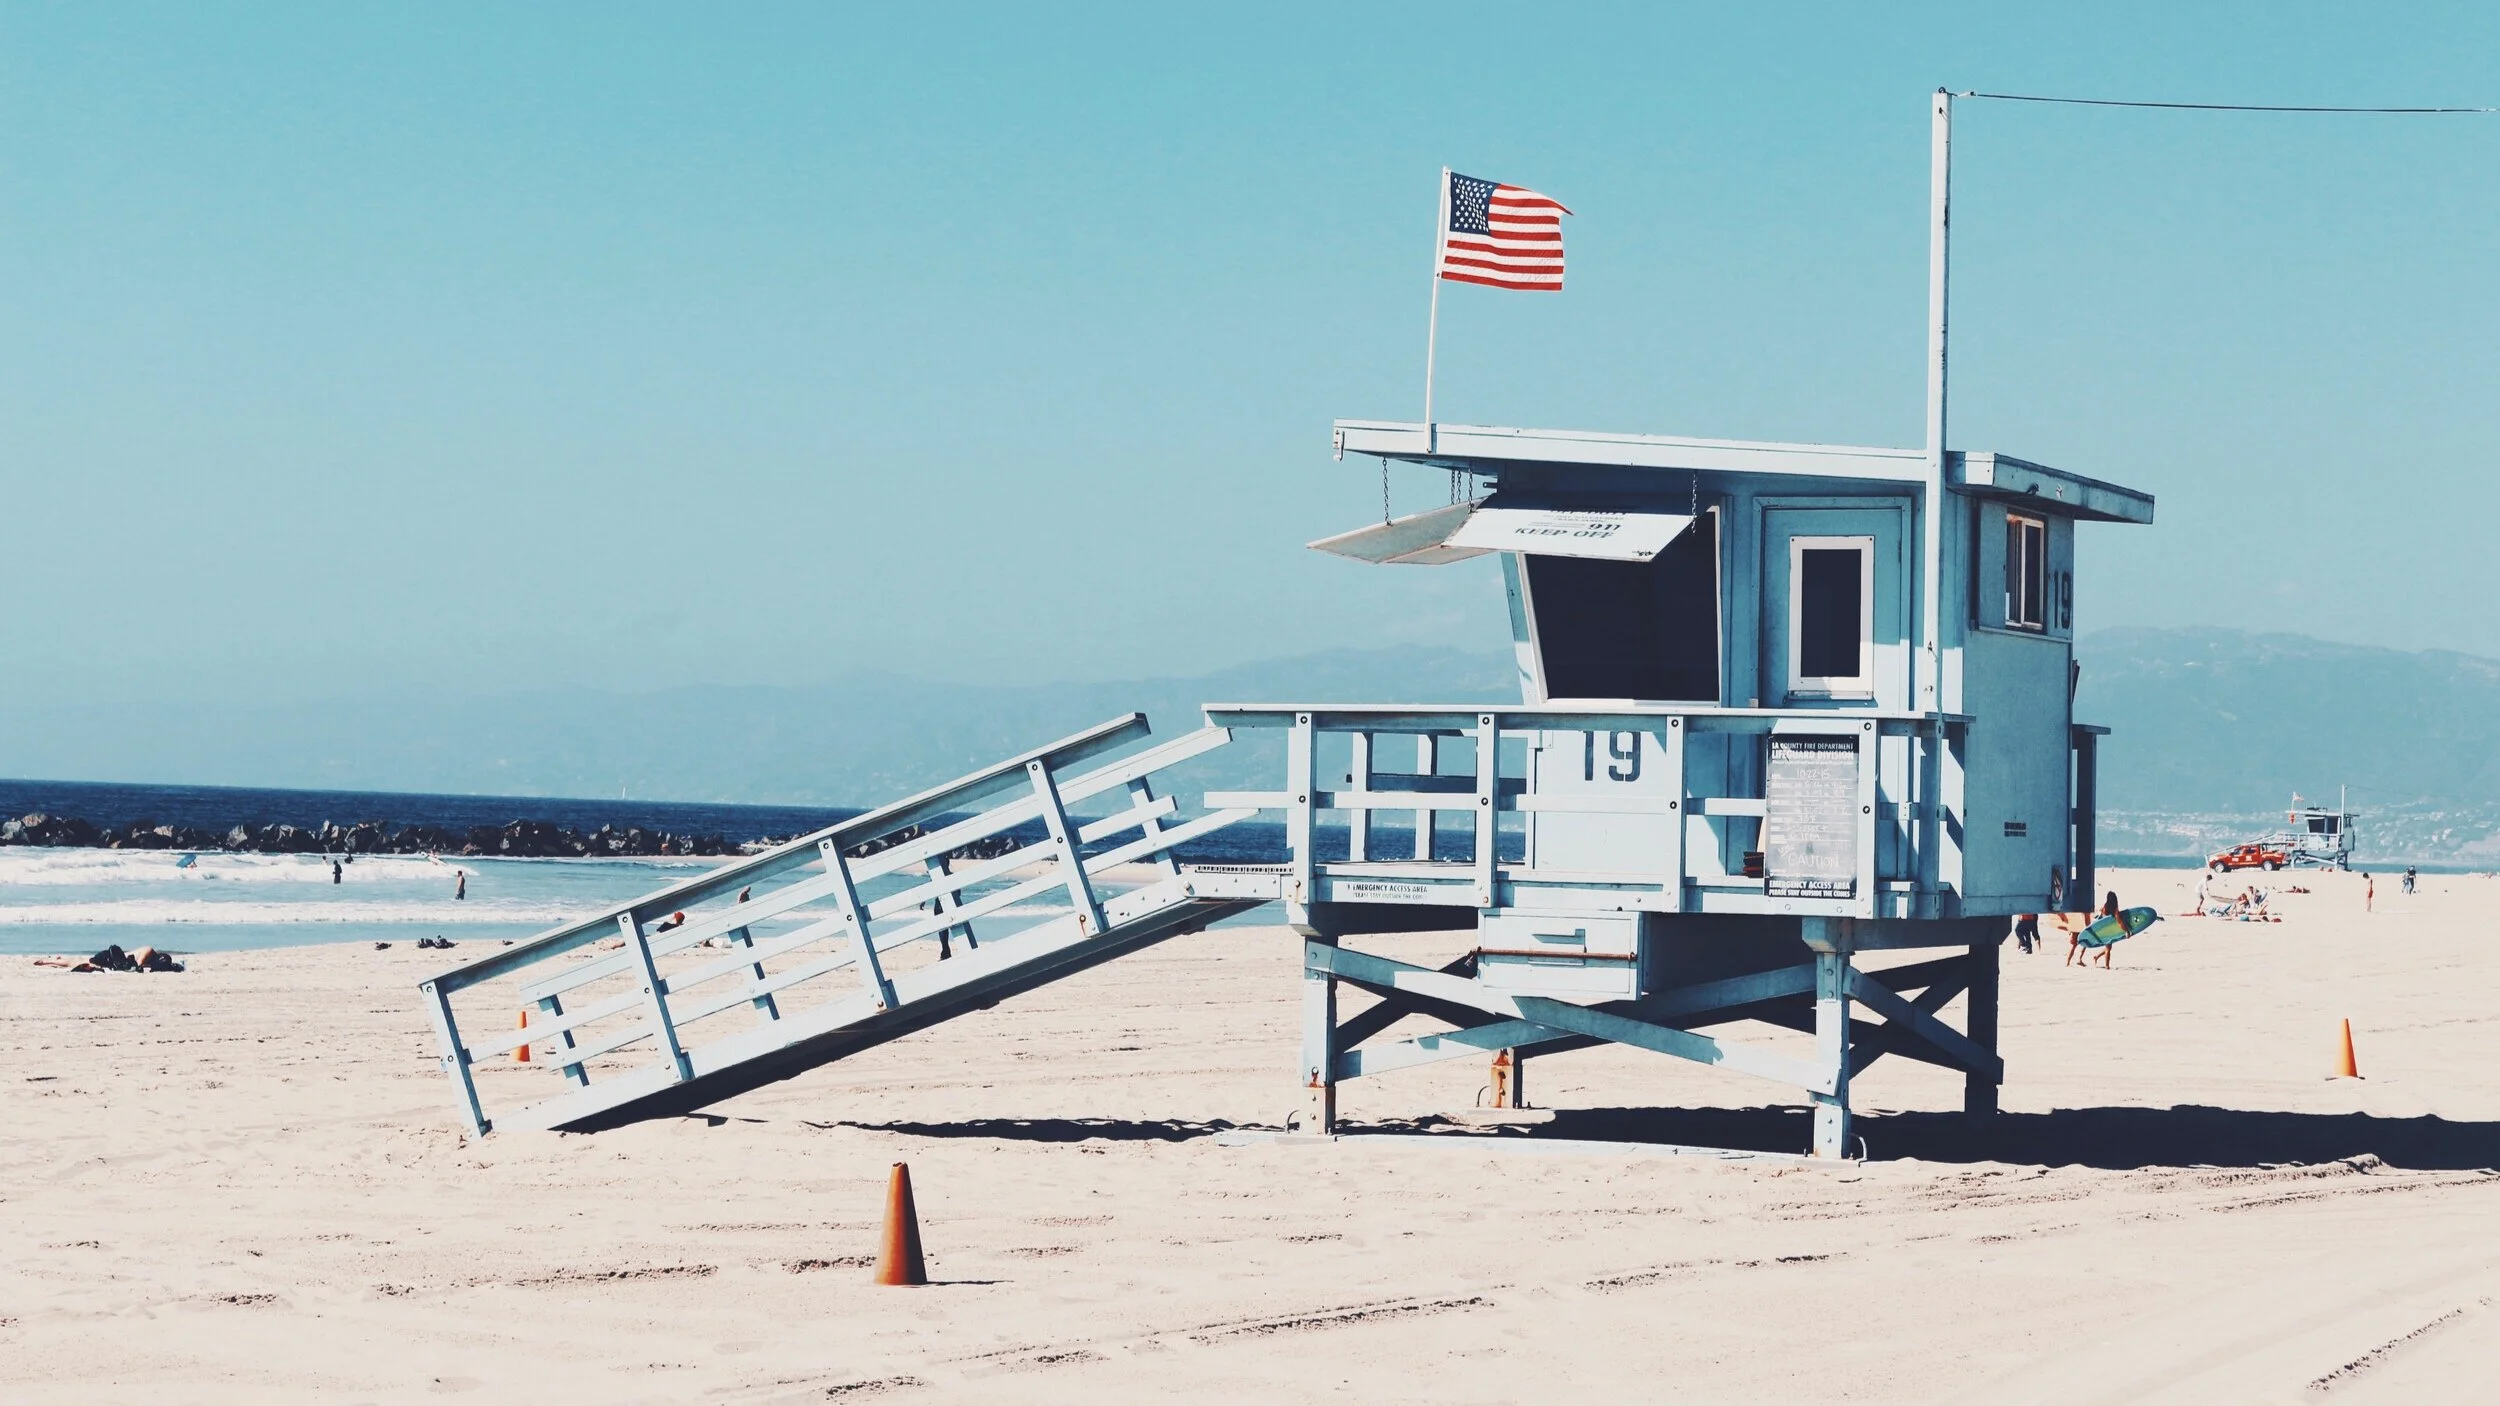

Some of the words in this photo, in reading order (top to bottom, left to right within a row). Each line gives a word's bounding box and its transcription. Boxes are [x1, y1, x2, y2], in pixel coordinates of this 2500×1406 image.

[1515, 527, 1568, 536] KEEP
[1573, 530, 1615, 539] OFF
[2053, 570, 2072, 630] 19
[1771, 741, 1780, 750] LA
[1780, 742, 1803, 750] COUNTY
[1804, 742, 1816, 750] FIRE
[1817, 742, 1854, 750] DEPARTMENT
[1583, 730, 1641, 782] 19
[1771, 750, 1816, 760] LIFEGUARD
[1817, 751, 1854, 760] DIVISION
[1787, 852, 1840, 869] CAUTION
[1412, 885, 1428, 893] AREA
[1769, 880, 1807, 889] EMERGENCY
[1808, 881, 1832, 889] ACCESS
[1833, 881, 1851, 890] AREA
[1800, 889, 1822, 897] OUTSIDE
